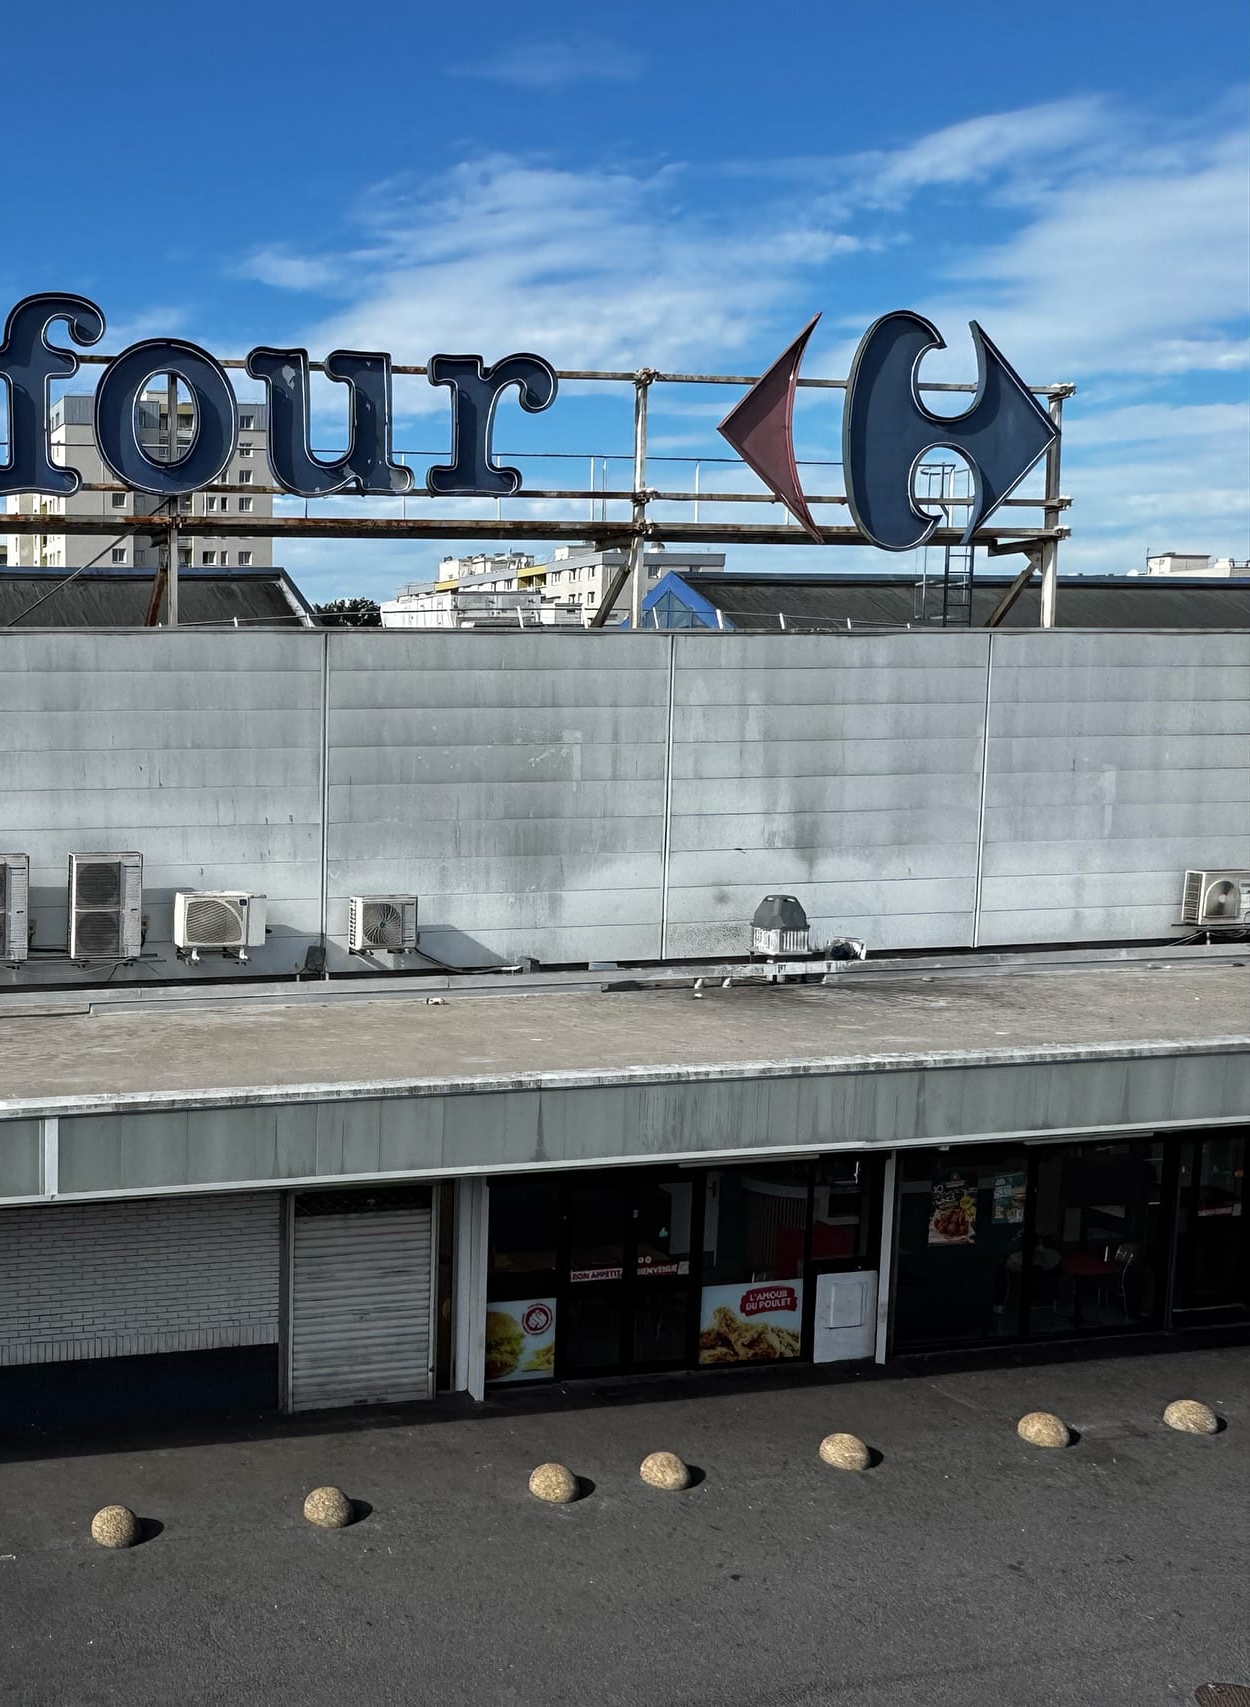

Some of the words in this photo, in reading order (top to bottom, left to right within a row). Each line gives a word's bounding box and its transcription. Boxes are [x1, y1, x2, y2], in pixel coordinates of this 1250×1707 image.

[749, 1289, 787, 1302] L'AMOUR
[745, 1301, 758, 1311] DU
[759, 1297, 791, 1309] POULET
